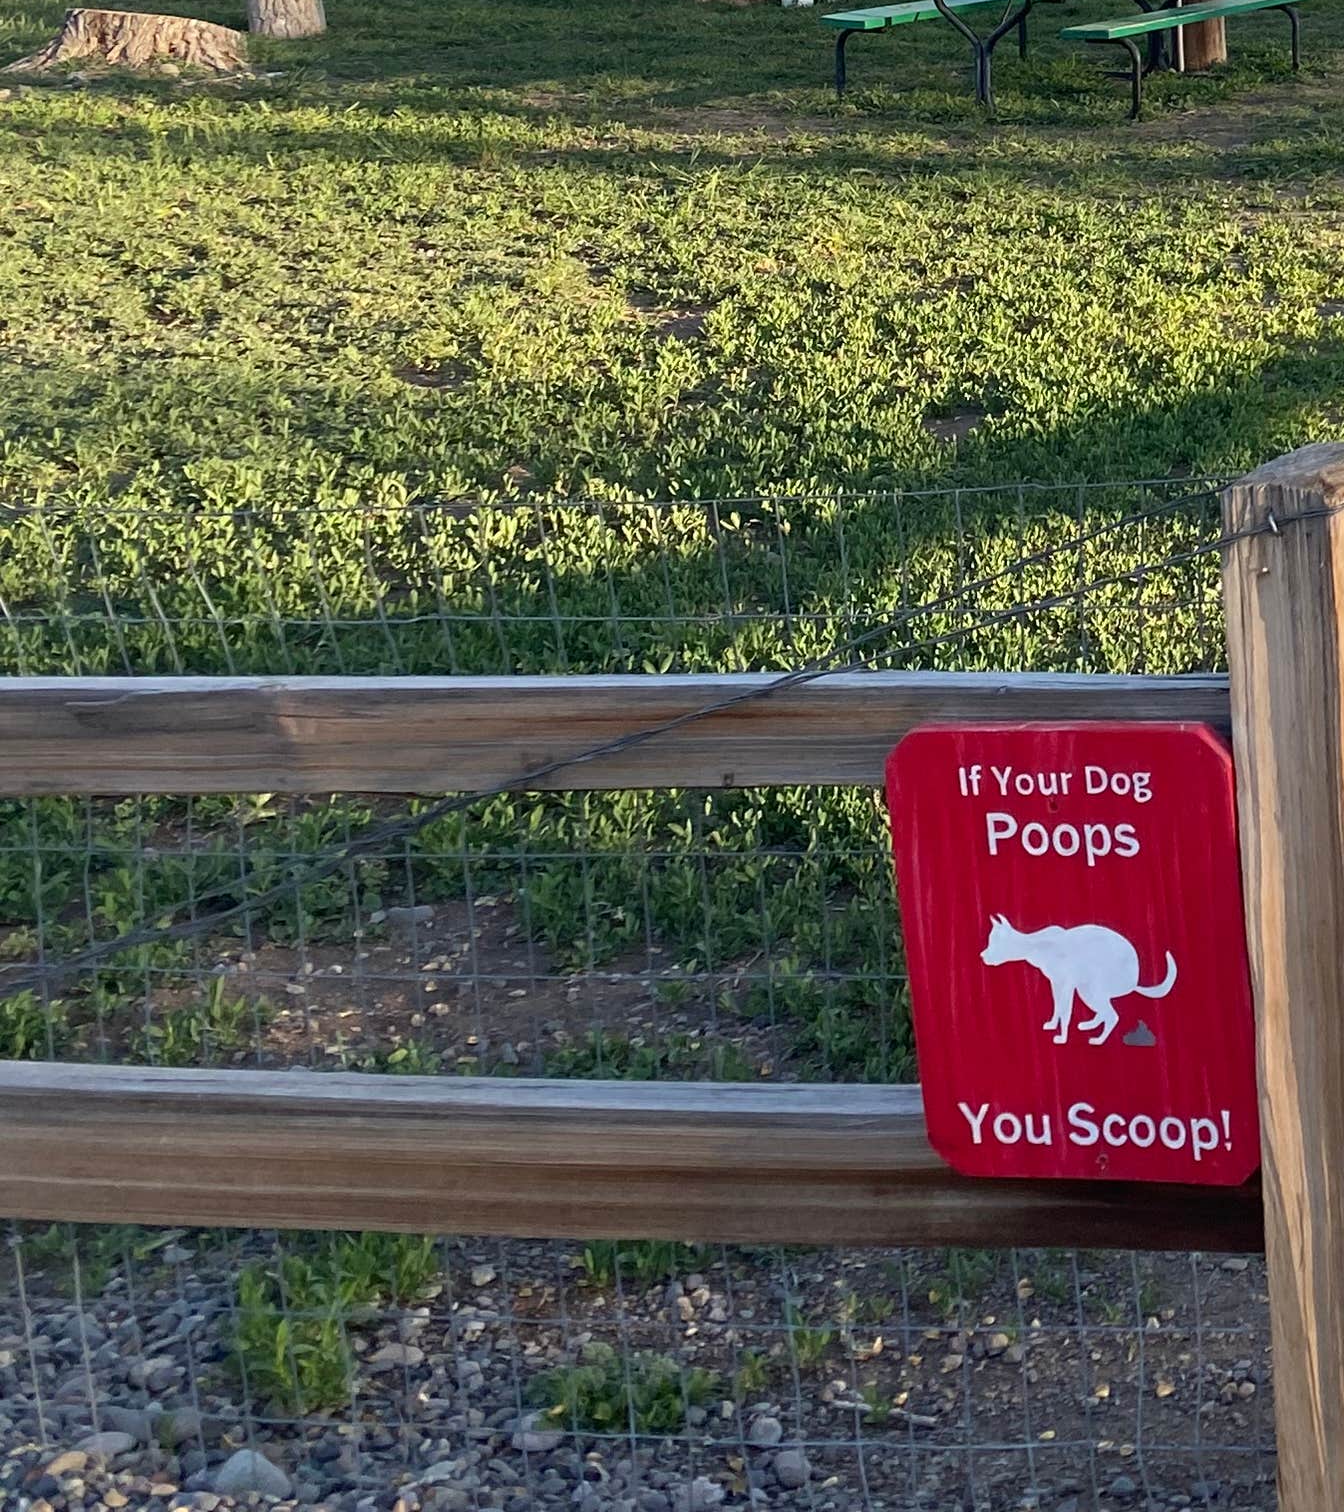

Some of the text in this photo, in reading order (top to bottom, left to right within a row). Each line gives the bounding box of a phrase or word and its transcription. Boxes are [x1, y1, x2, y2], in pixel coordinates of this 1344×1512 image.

[958, 765, 1153, 803] If Your Dog
[985, 812, 1140, 866] Poops
[957, 1101, 1232, 1161] You Scoop!
